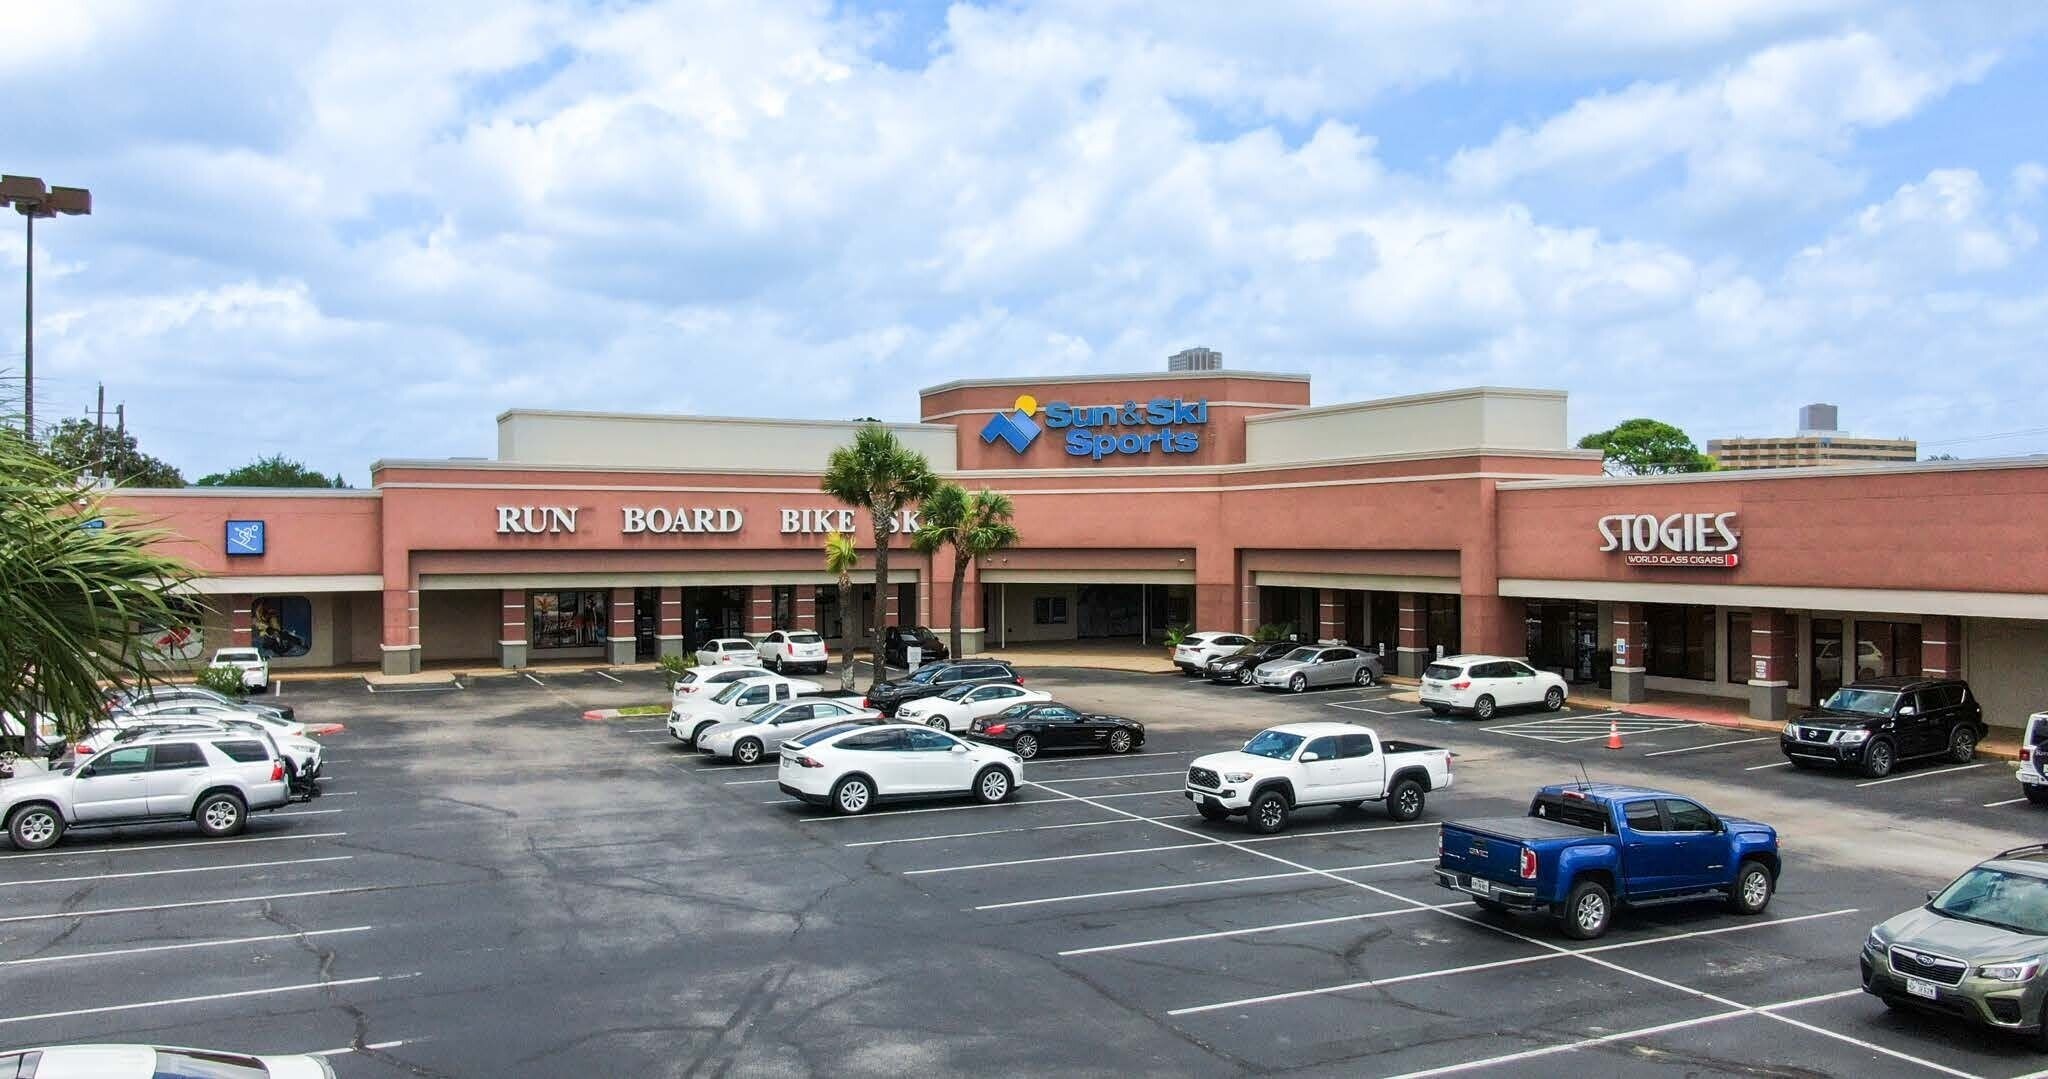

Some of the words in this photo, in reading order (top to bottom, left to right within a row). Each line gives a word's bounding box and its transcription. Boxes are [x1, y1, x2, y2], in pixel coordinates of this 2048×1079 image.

[1065, 428, 1199, 460] Sports
[496, 506, 579, 534] RUN
[622, 507, 743, 534] BOARD
[780, 508, 857, 533] BIKE
[888, 510, 930, 534] SK
[1597, 511, 1739, 552] STOGIES
[1628, 555, 1659, 564] WORLD
[1660, 555, 1689, 564] CLASS
[1689, 555, 1725, 565] CIGARS
[1468, 847, 1489, 858] GMC
